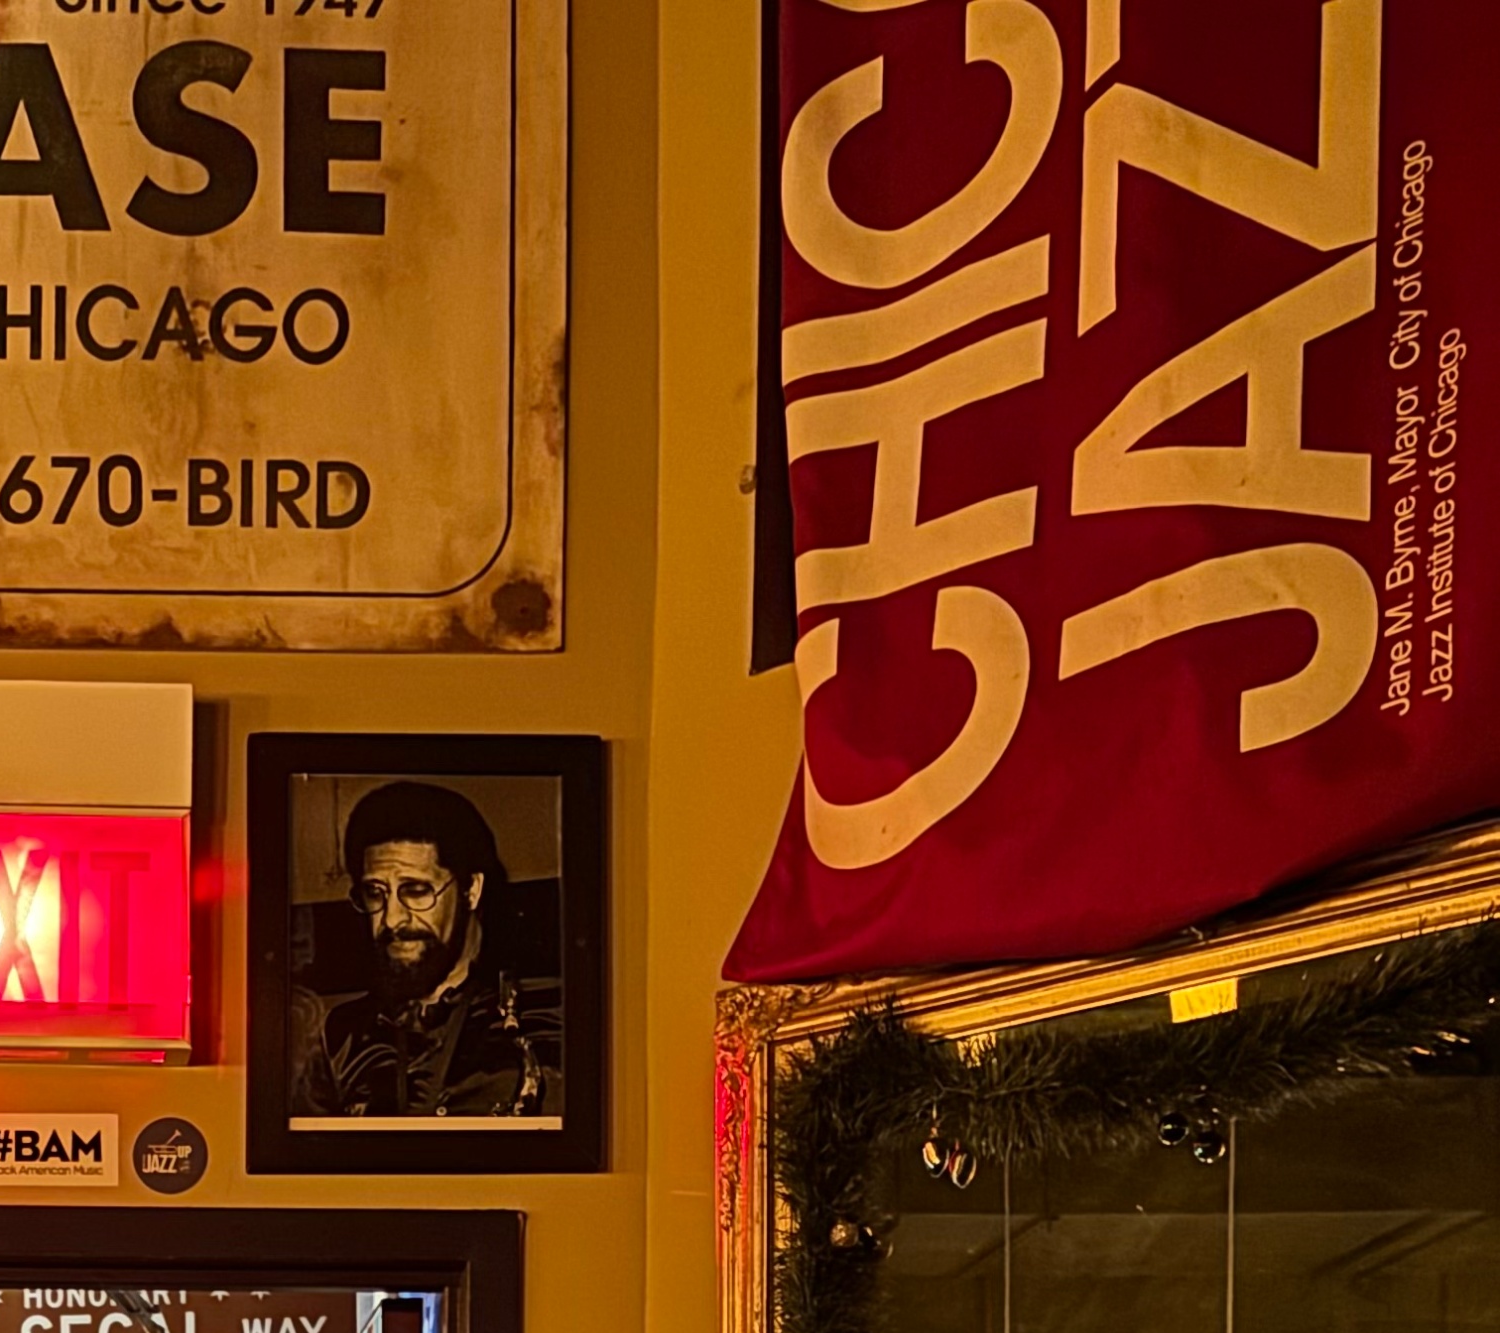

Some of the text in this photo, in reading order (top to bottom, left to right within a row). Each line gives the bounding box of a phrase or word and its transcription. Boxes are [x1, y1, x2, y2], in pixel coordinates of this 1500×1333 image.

[780, 0, 1063, 870] CHIC
[1058, 0, 1382, 754] JAZ
[1380, 140, 1433, 716] Jane M. Byrne, Mayor City of Chicago
[1422, 328, 1466, 702] Jazz Institute of Chicago
[19, 1165, 71, 1175] American
[73, 1165, 103, 1175] Music
[142, 1153, 177, 1173] JAZZ
[177, 1145, 192, 1158] UP
